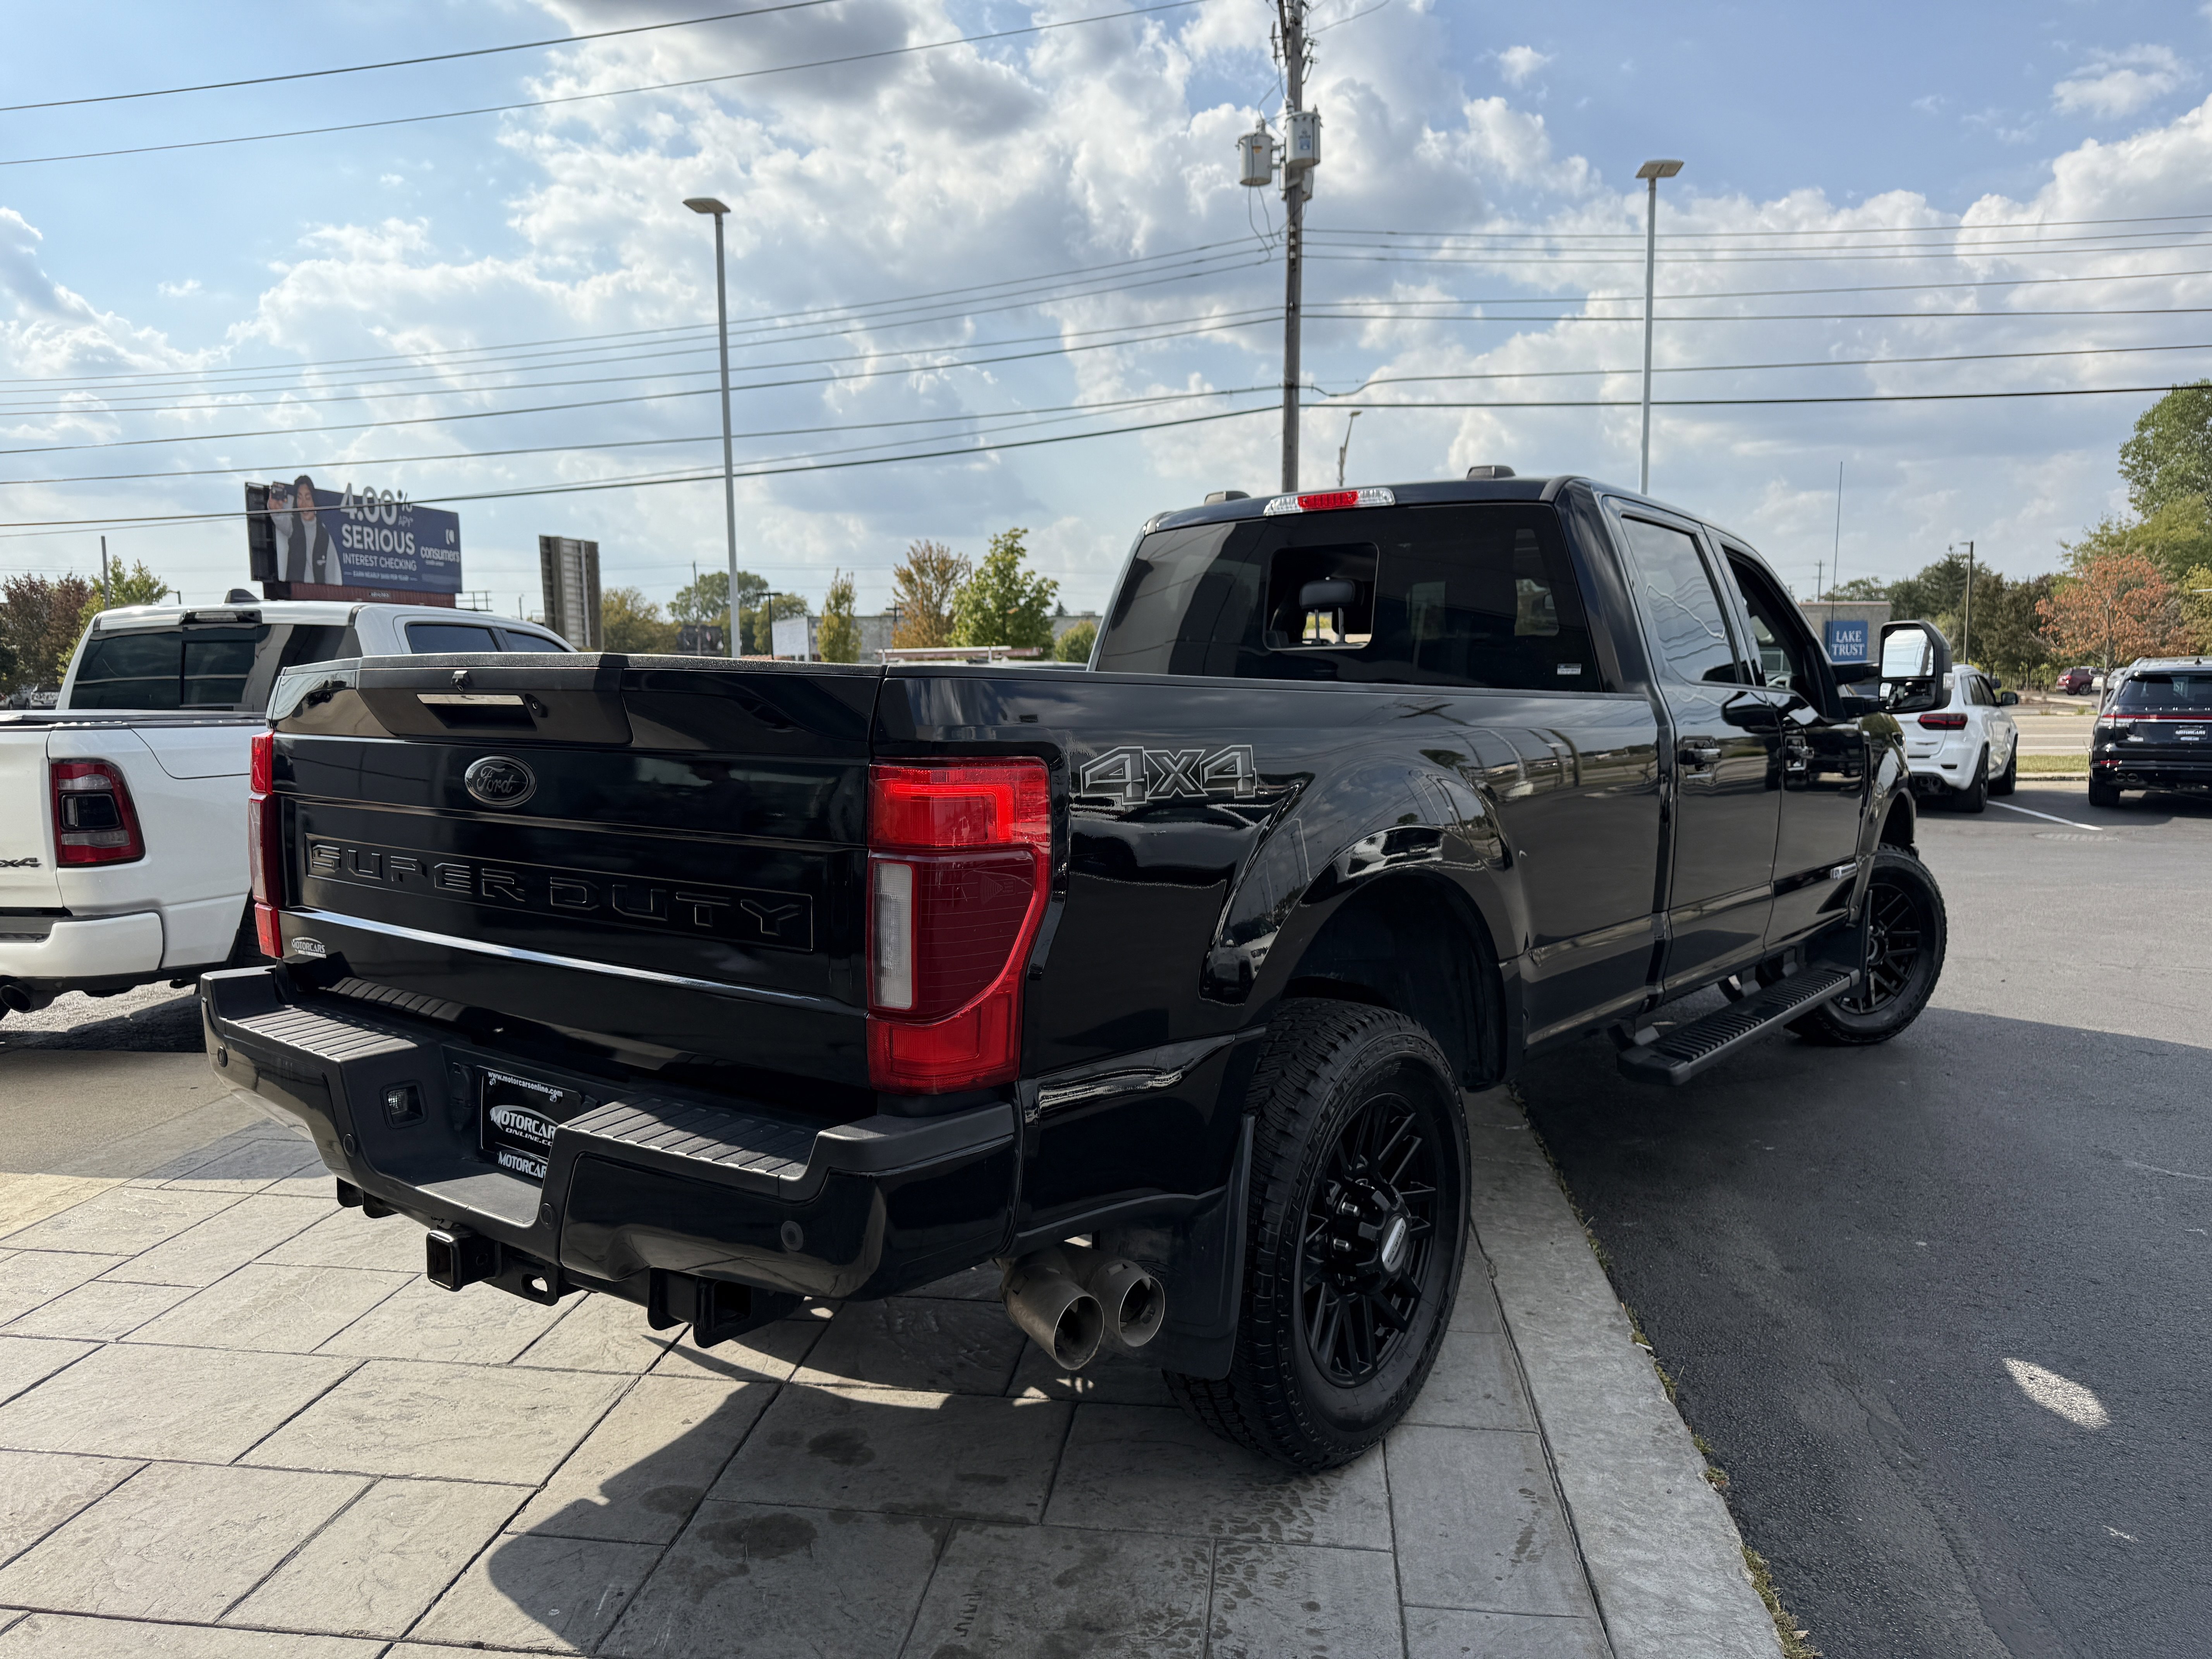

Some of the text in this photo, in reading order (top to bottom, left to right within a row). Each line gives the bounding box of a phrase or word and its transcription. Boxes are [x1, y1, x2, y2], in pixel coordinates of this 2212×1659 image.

[342, 524, 416, 555] SERIOUS
[343, 552, 378, 567] INTEREST
[379, 556, 417, 571] CHECKING
[420, 546, 460, 562] consumers
[1836, 630, 1862, 643] LAKE
[1831, 644, 1865, 656] TRUST
[476, 765, 514, 794] Ford
[311, 844, 802, 936] SUPER DUTY
[291, 939, 325, 953] MOTORCARS
[488, 1071, 563, 1097] www.motorcarsonline.com
[491, 1107, 557, 1140] MOTORCAR
[498, 1151, 547, 1178] MOTORCAR
